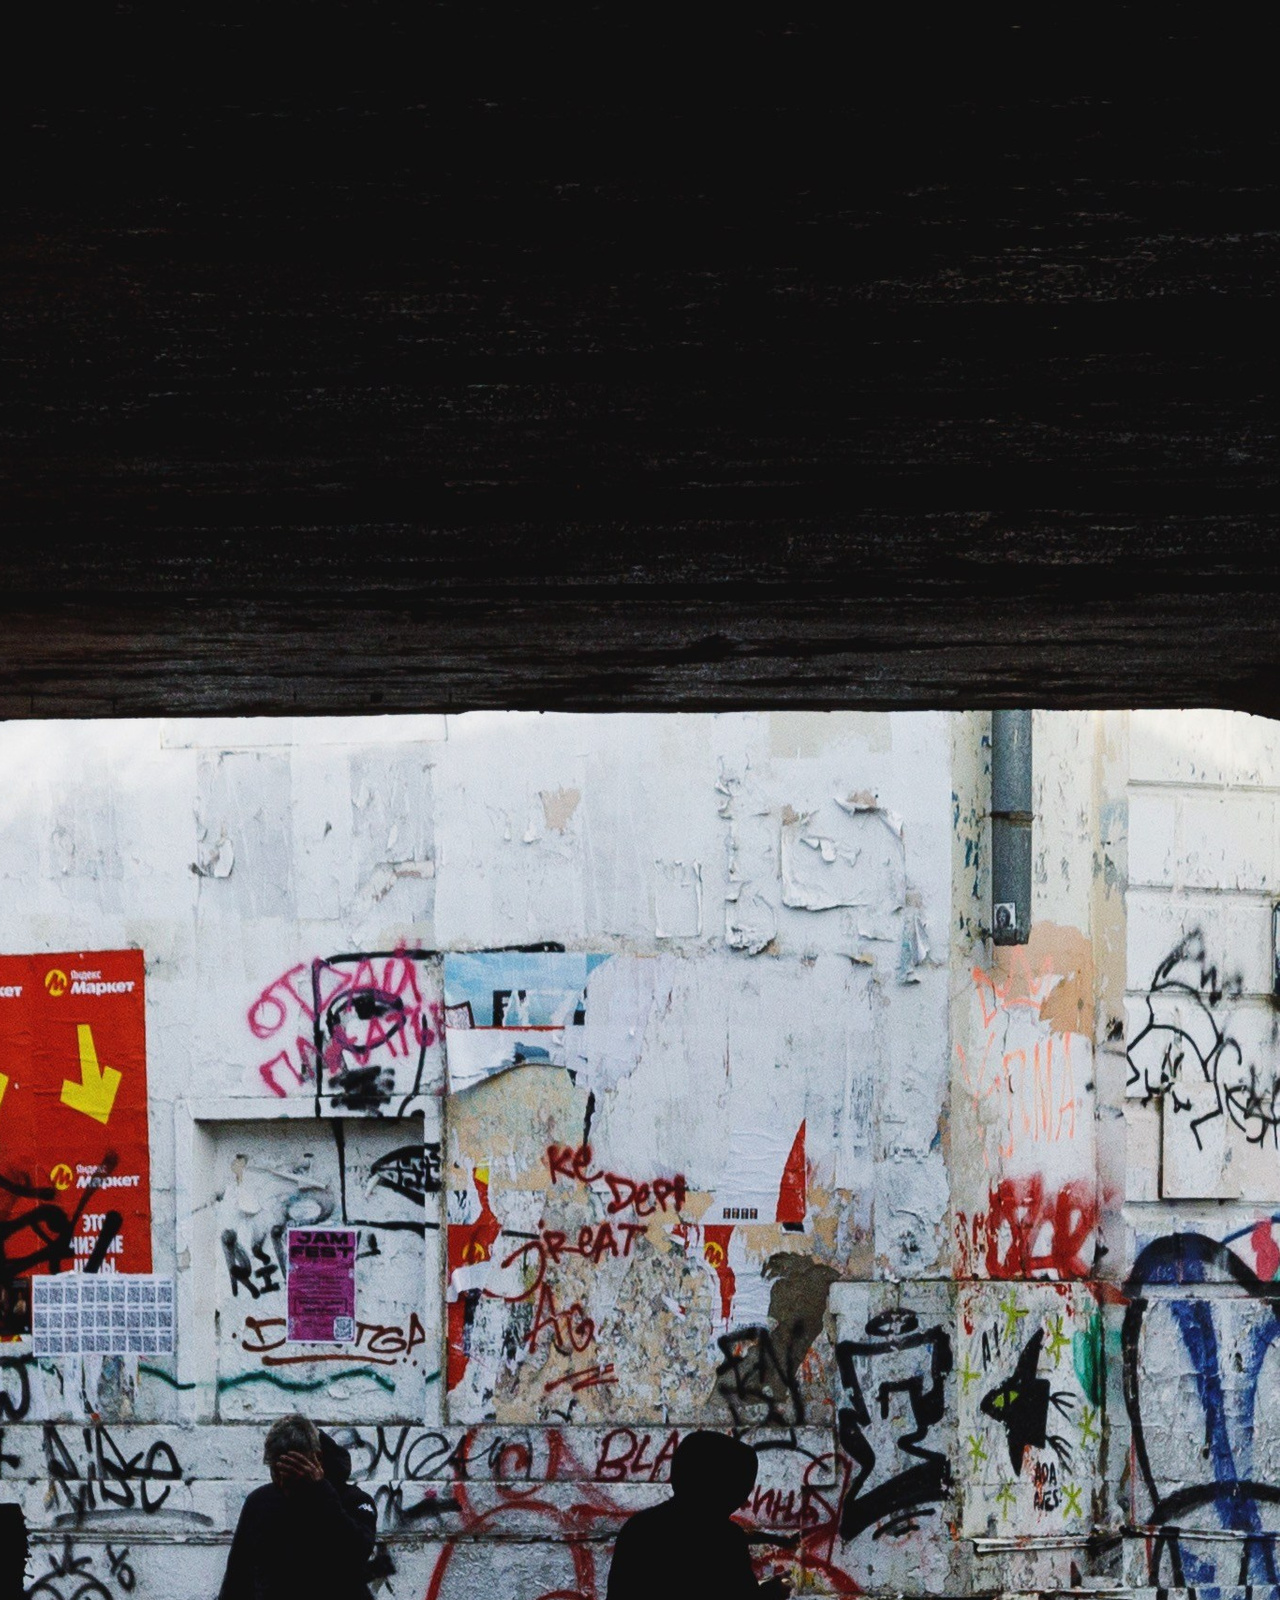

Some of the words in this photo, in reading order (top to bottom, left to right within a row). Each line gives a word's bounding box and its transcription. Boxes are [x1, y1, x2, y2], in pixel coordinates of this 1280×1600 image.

[70, 980, 135, 996] Маркет
[76, 1175, 140, 1190] Маркет
[69, 1235, 124, 1255] НИЗИЕ
[297, 1232, 349, 1244] JAM
